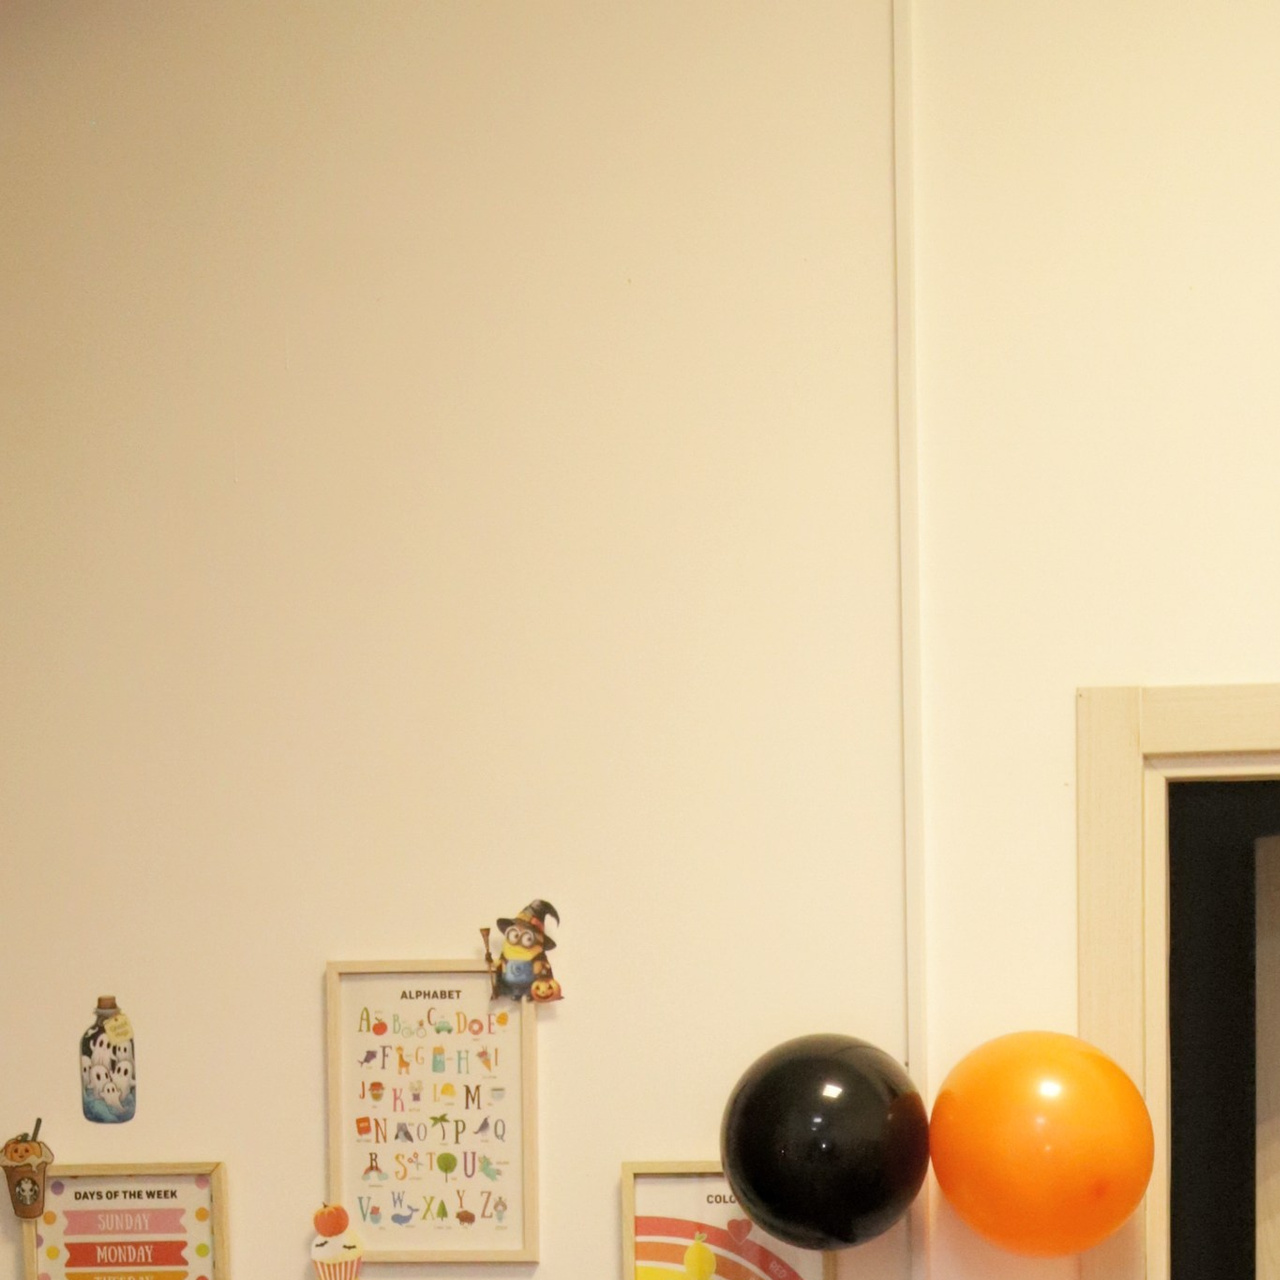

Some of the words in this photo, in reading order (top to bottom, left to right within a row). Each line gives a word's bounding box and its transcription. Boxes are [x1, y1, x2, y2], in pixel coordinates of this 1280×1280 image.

[400, 990, 462, 1000] ALPHABET
[358, 1006, 371, 1033] A
[392, 1014, 401, 1034] B
[427, 1007, 436, 1026] C
[455, 1011, 468, 1035] D
[487, 1013, 497, 1034] E
[380, 1045, 393, 1070] F
[415, 1047, 425, 1065] G
[457, 1050, 470, 1074] H
[359, 1081, 365, 1100] J
[392, 1088, 405, 1112] K
[433, 1083, 440, 1102] L
[464, 1084, 482, 1110] M
[373, 1118, 387, 1144] N
[416, 1122, 428, 1142] O
[454, 1119, 466, 1144] P
[494, 1119, 506, 1142] Q
[369, 1152, 378, 1171] R
[394, 1153, 408, 1181] S
[426, 1152, 436, 1171] T
[463, 1151, 476, 1178] U
[74, 1190, 103, 1201] DAYS
[105, 1190, 120, 1200] OF
[122, 1190, 143, 1199] THE
[145, 1189, 178, 1199] WEEK
[357, 1196, 372, 1222] V
[391, 1190, 405, 1209] W
[421, 1196, 435, 1221] X
[456, 1189, 465, 1209] Y
[480, 1190, 493, 1219] Z
[706, 1194, 737, 1204] COLO
[97, 1213, 151, 1231] SUNDAY
[96, 1244, 154, 1263] MONDAY
[769, 1260, 788, 1279] RED
